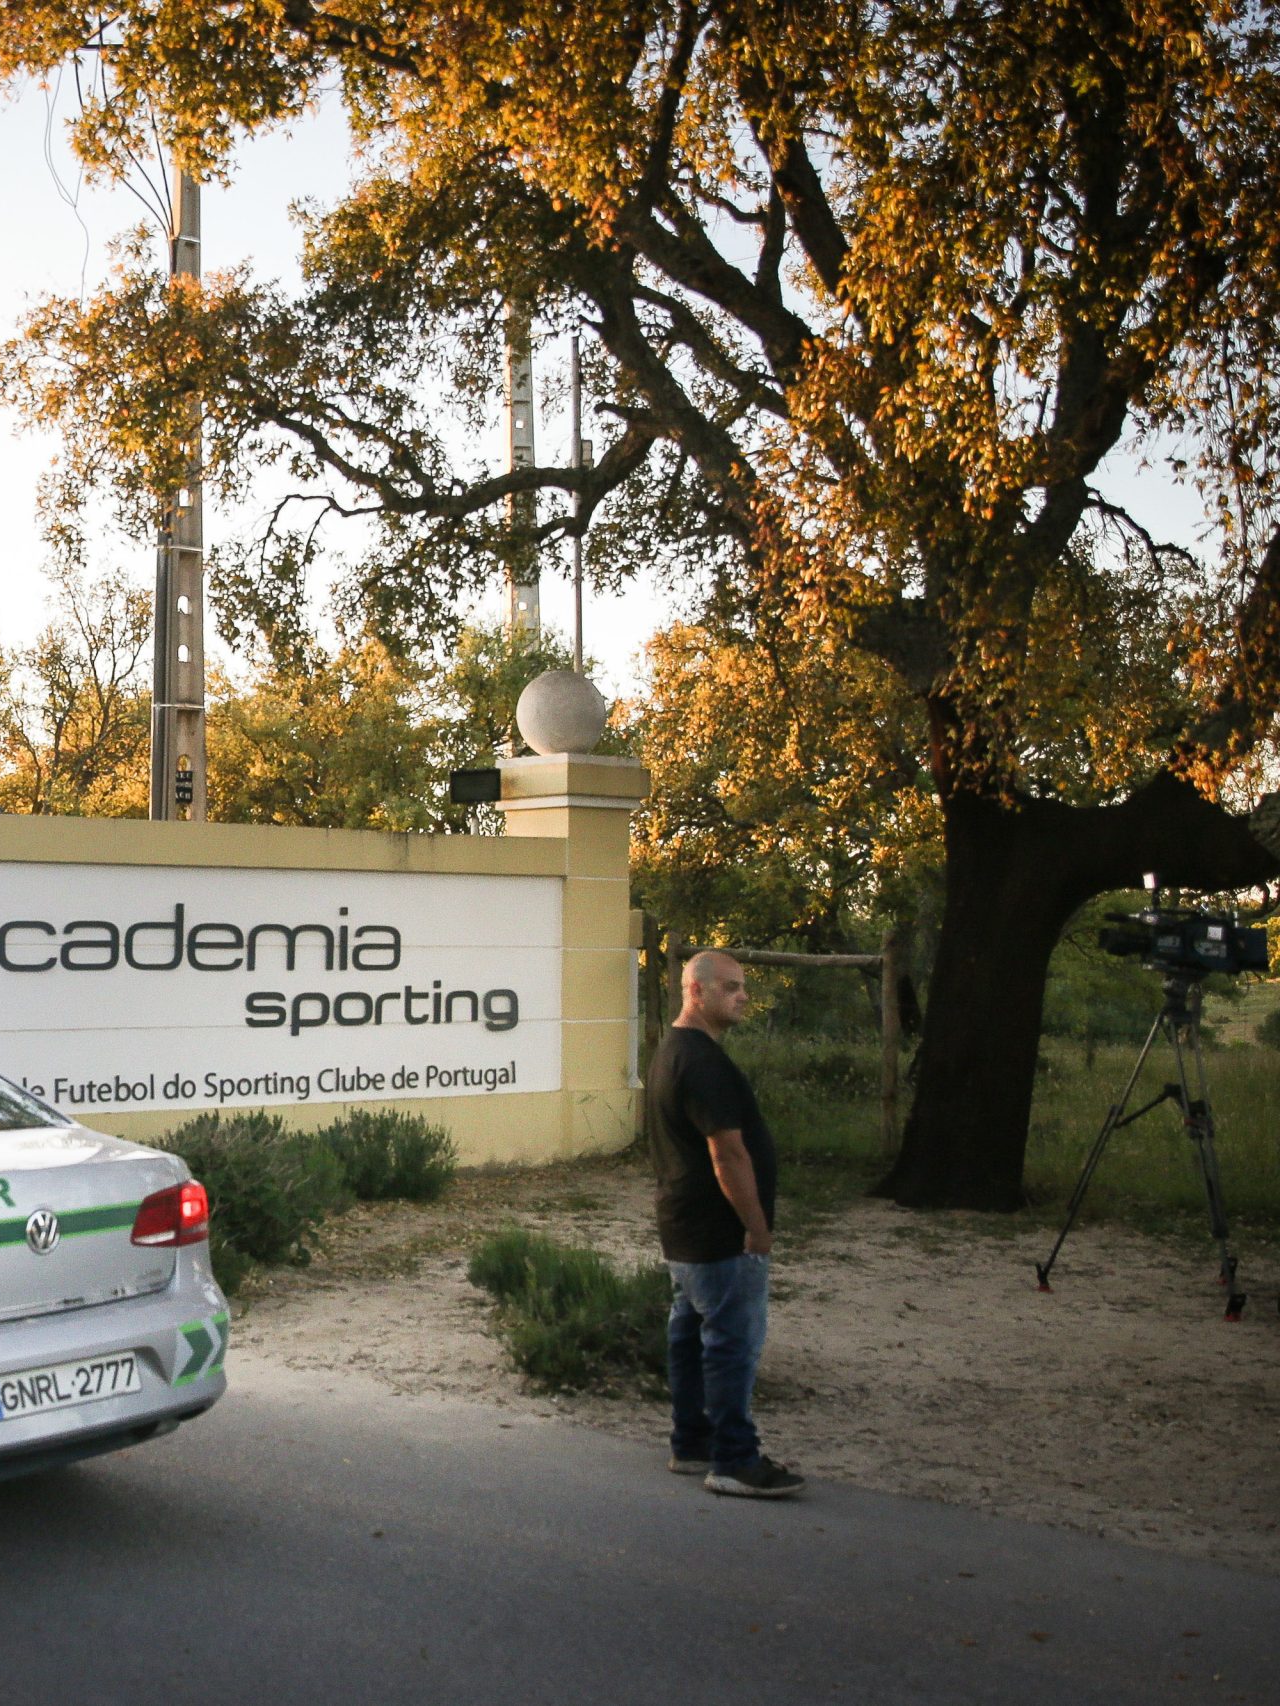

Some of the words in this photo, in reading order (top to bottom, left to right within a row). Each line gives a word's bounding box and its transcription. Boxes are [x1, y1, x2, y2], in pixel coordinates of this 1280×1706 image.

[244, 979, 520, 1037] sporting
[53, 1073, 156, 1104] Futebol
[162, 1072, 197, 1100] do
[203, 1071, 311, 1104] Sporting
[316, 1065, 386, 1093] Clube
[391, 1065, 420, 1090] de
[425, 1060, 517, 1092] Portugal
